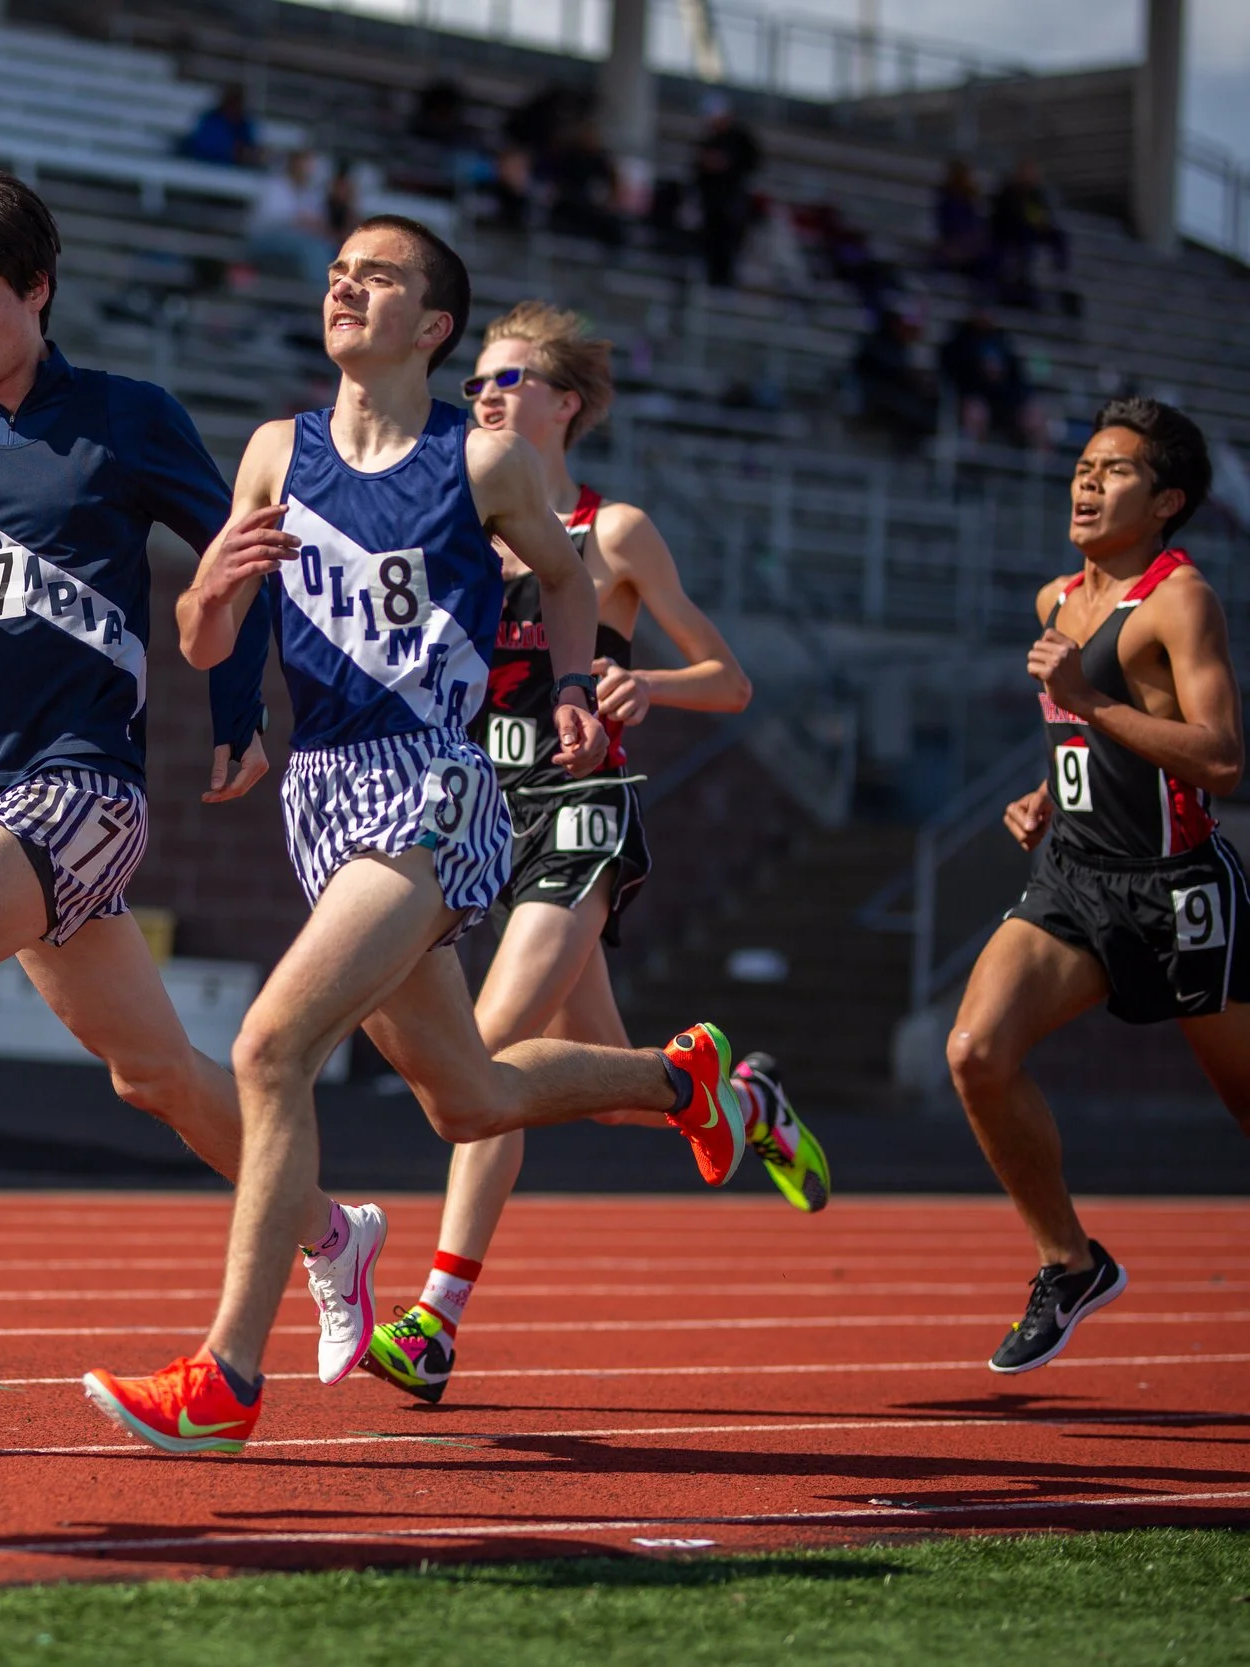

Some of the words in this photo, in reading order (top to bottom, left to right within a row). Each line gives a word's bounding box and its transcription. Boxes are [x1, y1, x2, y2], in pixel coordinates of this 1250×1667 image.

[379, 556, 418, 625] 8
[494, 721, 526, 762] 10
[434, 765, 469, 834] 8
[1063, 750, 1082, 806] 9
[70, 815, 121, 872] 7
[571, 807, 609, 847] 10
[1184, 889, 1213, 945] 9
